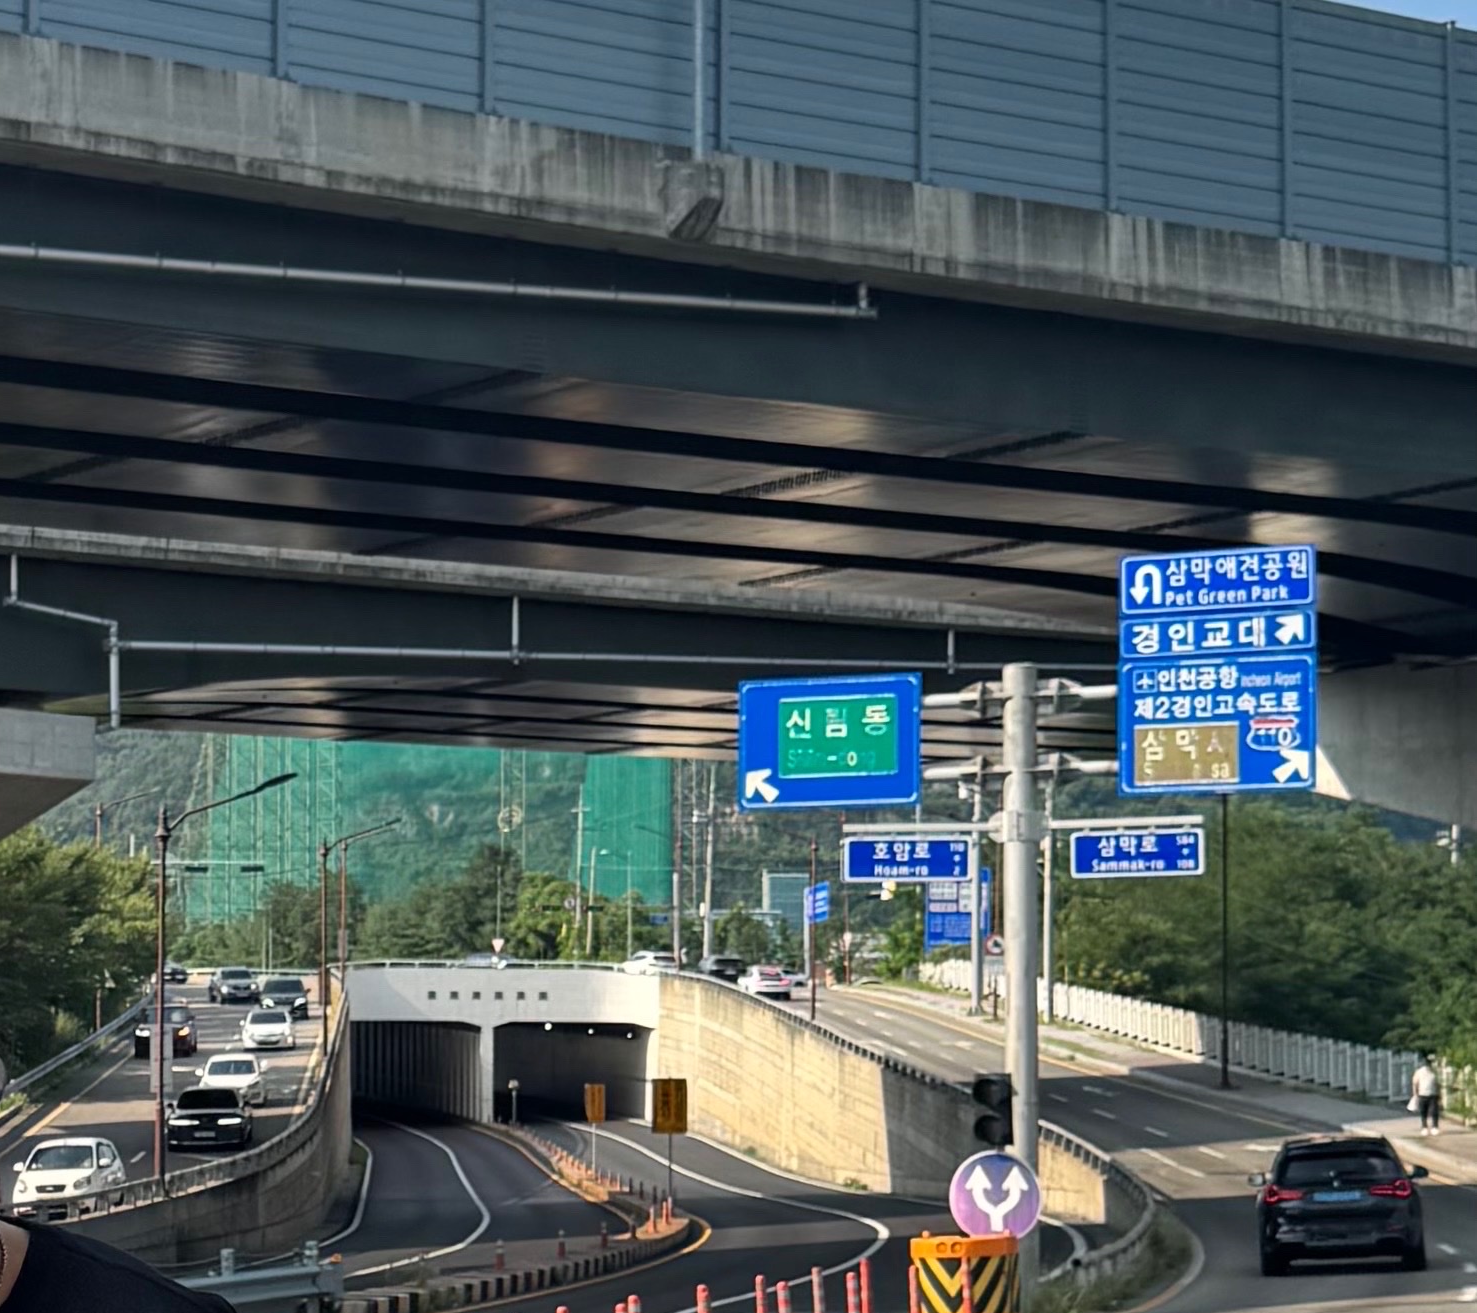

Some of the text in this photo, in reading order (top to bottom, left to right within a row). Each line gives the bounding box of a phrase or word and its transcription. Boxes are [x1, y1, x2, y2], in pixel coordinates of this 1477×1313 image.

[1166, 551, 1308, 587] 삼막애견공원
[1165, 585, 1289, 607] Pet Green Park
[1131, 616, 1266, 655] 경인교대
[1157, 665, 1239, 692] 인천공항
[1133, 691, 1301, 720] 제2경인고속도로
[785, 704, 891, 739] 신림동
[872, 842, 931, 862] 호암로
[1097, 836, 1159, 857] 삼막로
[874, 864, 929, 876] Hoam-ro
[1091, 858, 1166, 873] Sammak-ro
